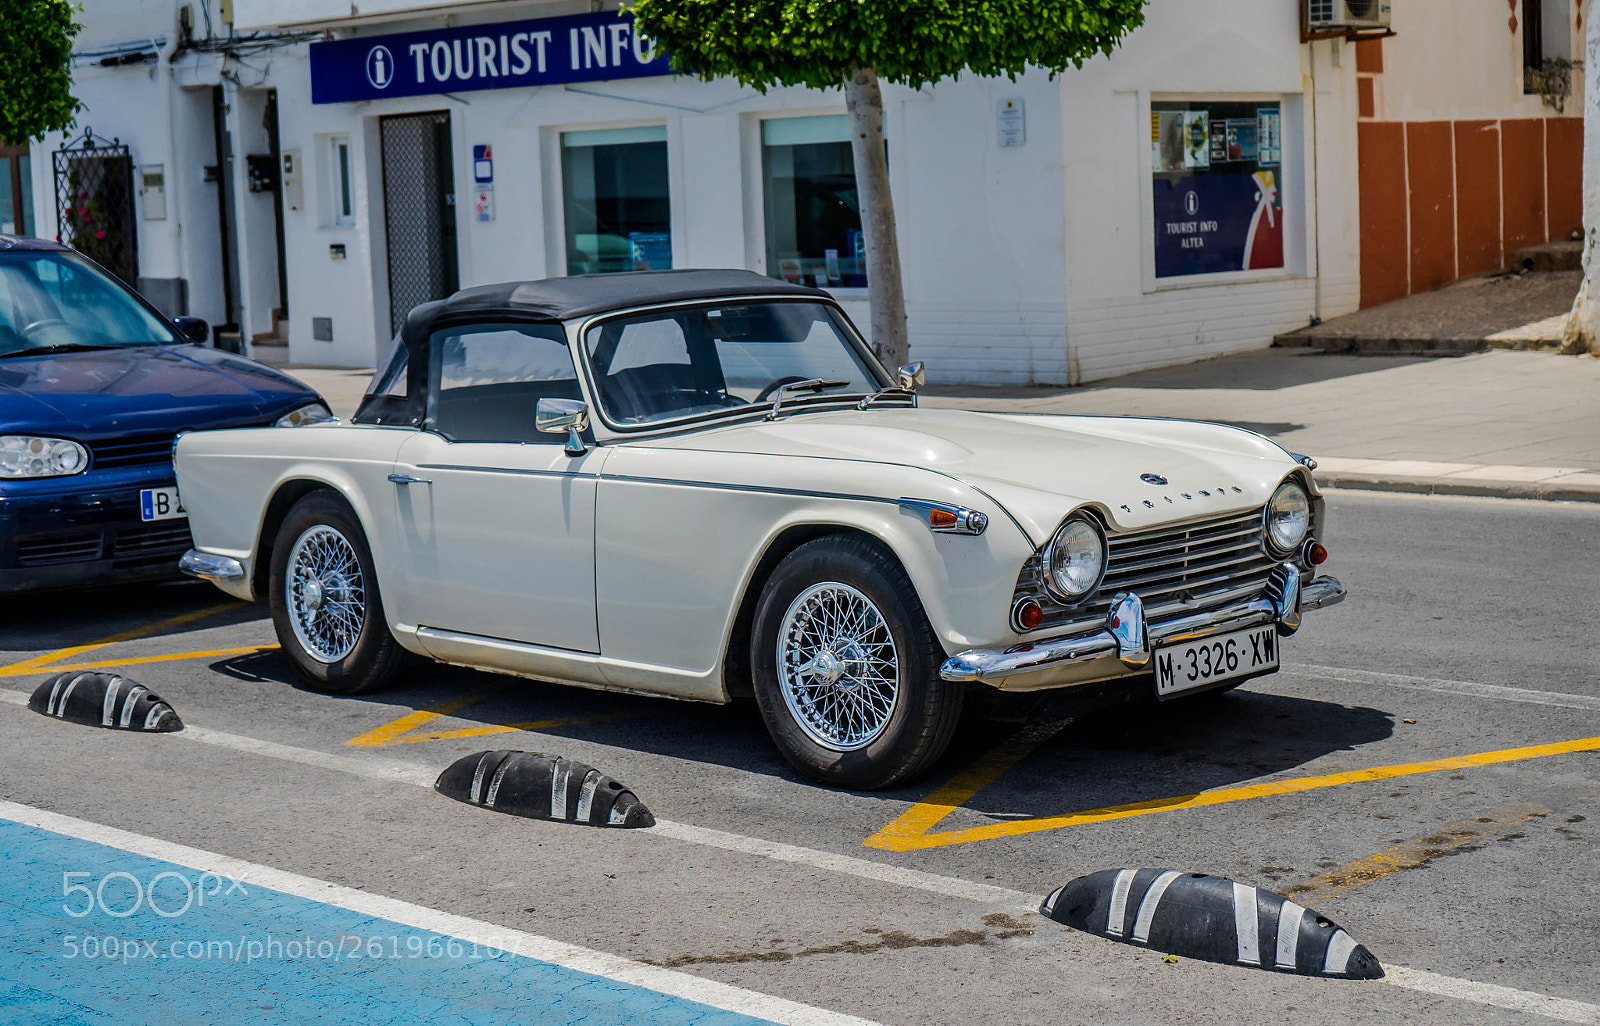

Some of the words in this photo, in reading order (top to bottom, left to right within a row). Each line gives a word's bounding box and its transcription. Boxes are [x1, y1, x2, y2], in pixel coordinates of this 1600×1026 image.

[409, 31, 552, 84] TOURIST
[569, 22, 658, 71] INFO
[1166, 221, 1198, 235] TOURIST
[1200, 220, 1218, 233] INFO
[1181, 236, 1205, 249] ALTEA
